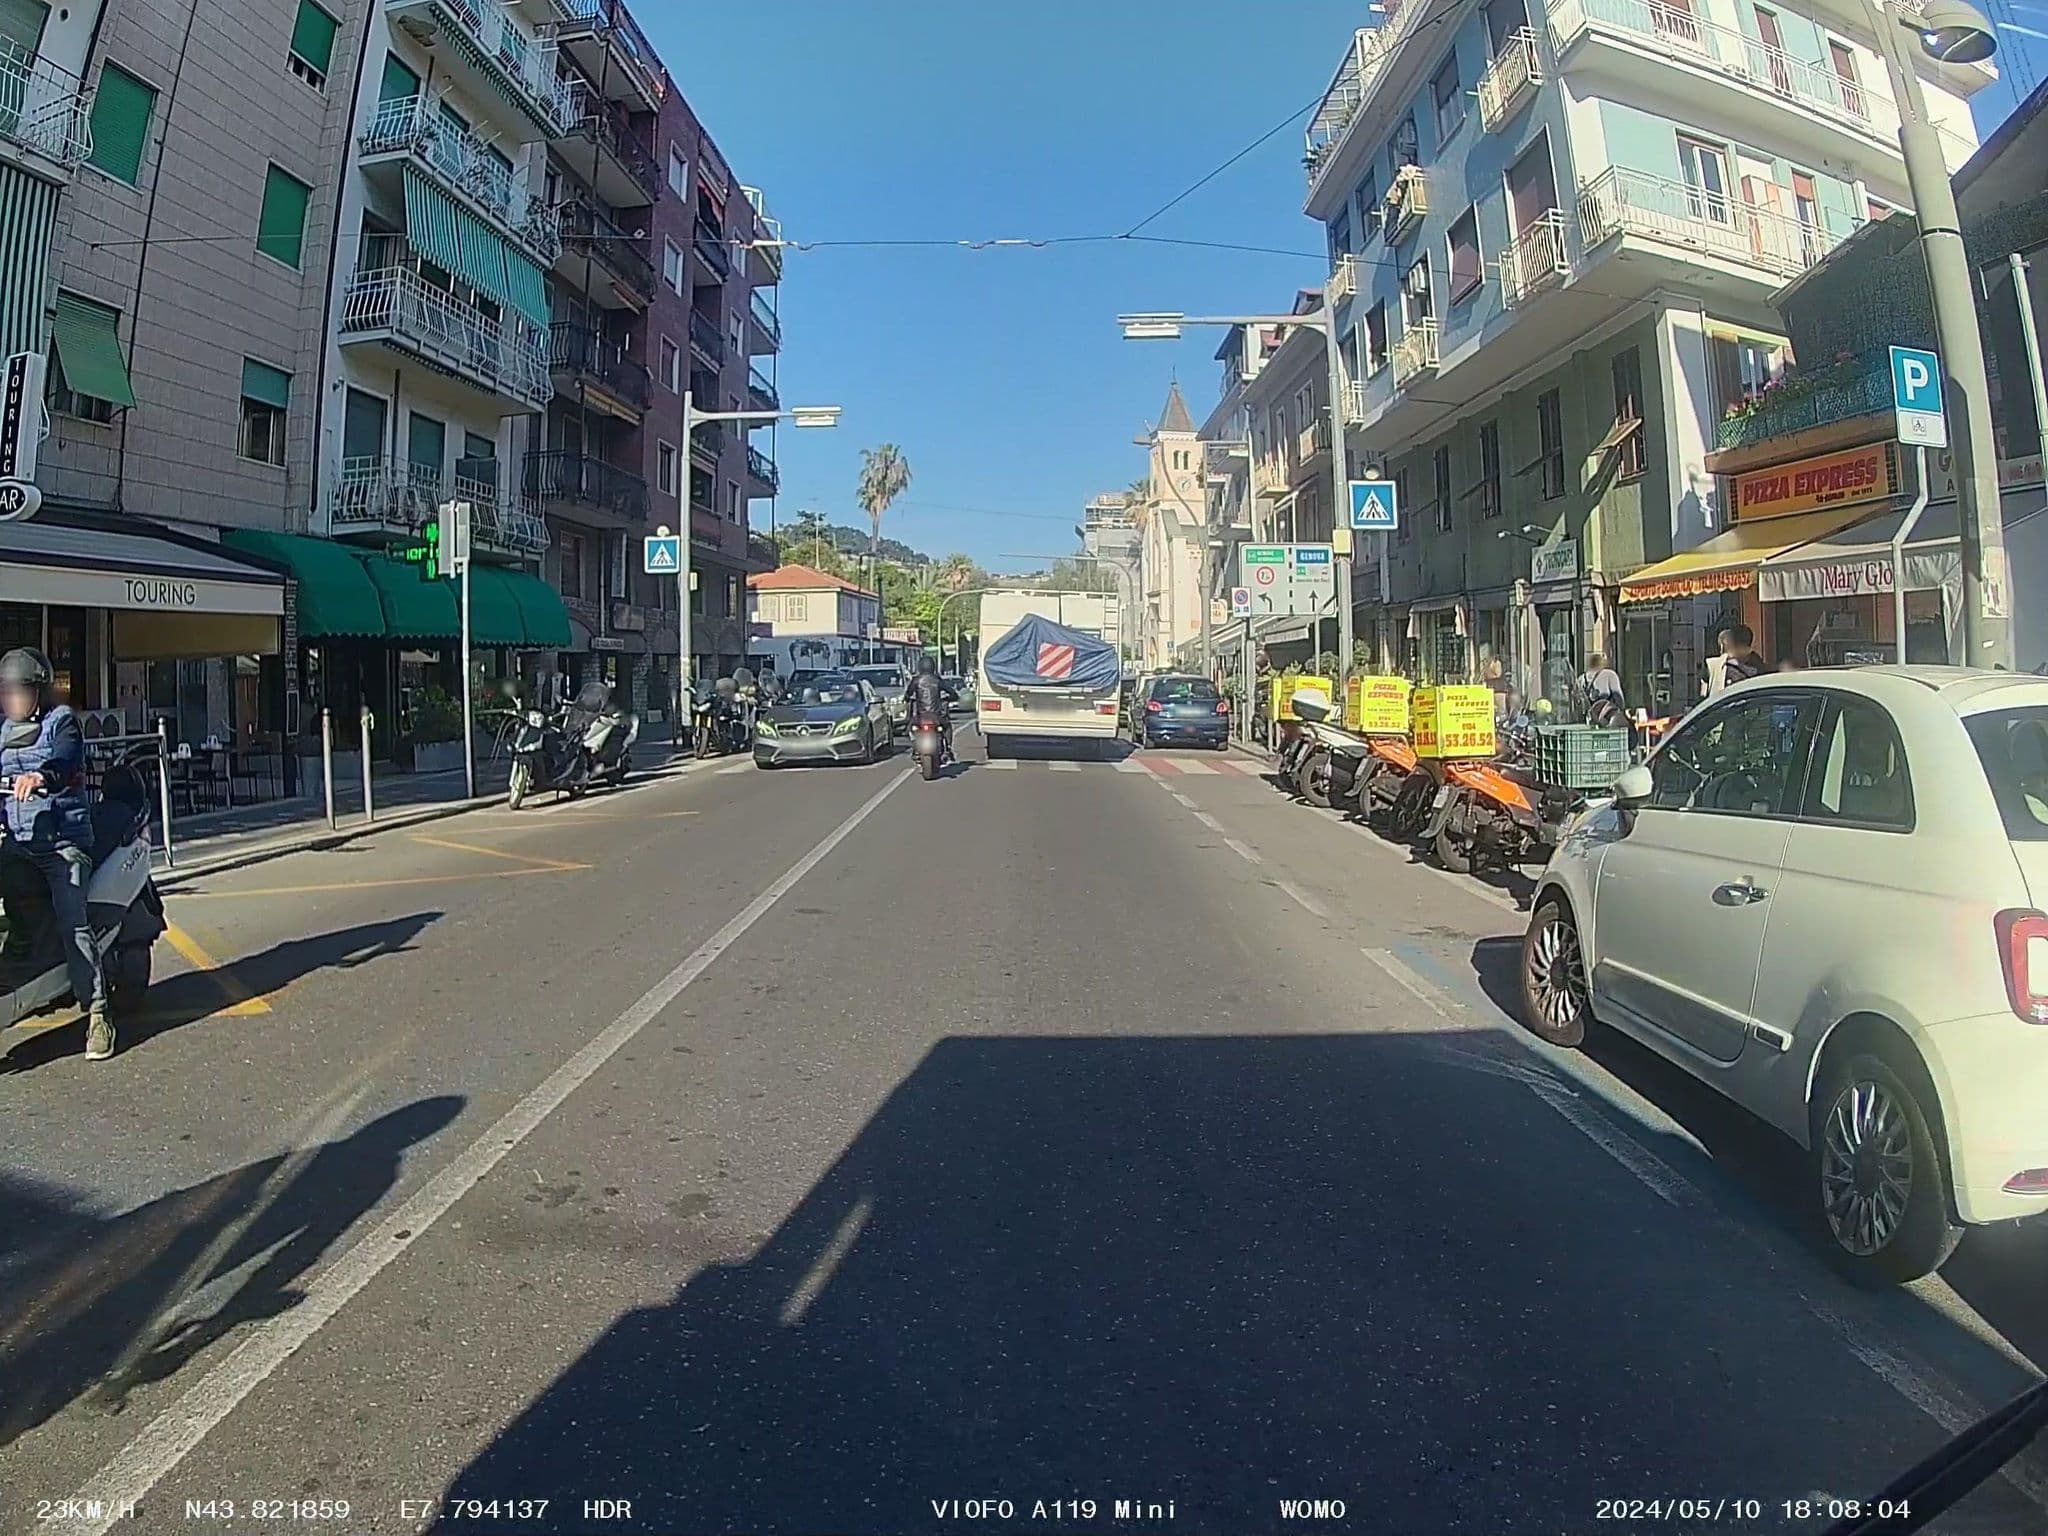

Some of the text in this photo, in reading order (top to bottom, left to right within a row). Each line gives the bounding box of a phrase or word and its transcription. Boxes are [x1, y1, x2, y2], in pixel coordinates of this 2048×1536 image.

[1902, 358, 1929, 400] P
[3, 358, 22, 473] TOURING
[1743, 477, 1790, 506] PIZZA
[1794, 456, 1878, 496] EXPRESS
[125, 579, 196, 605] TOURING
[1823, 566, 1863, 593] Mary
[1444, 732, 1493, 748] 53.26.52
